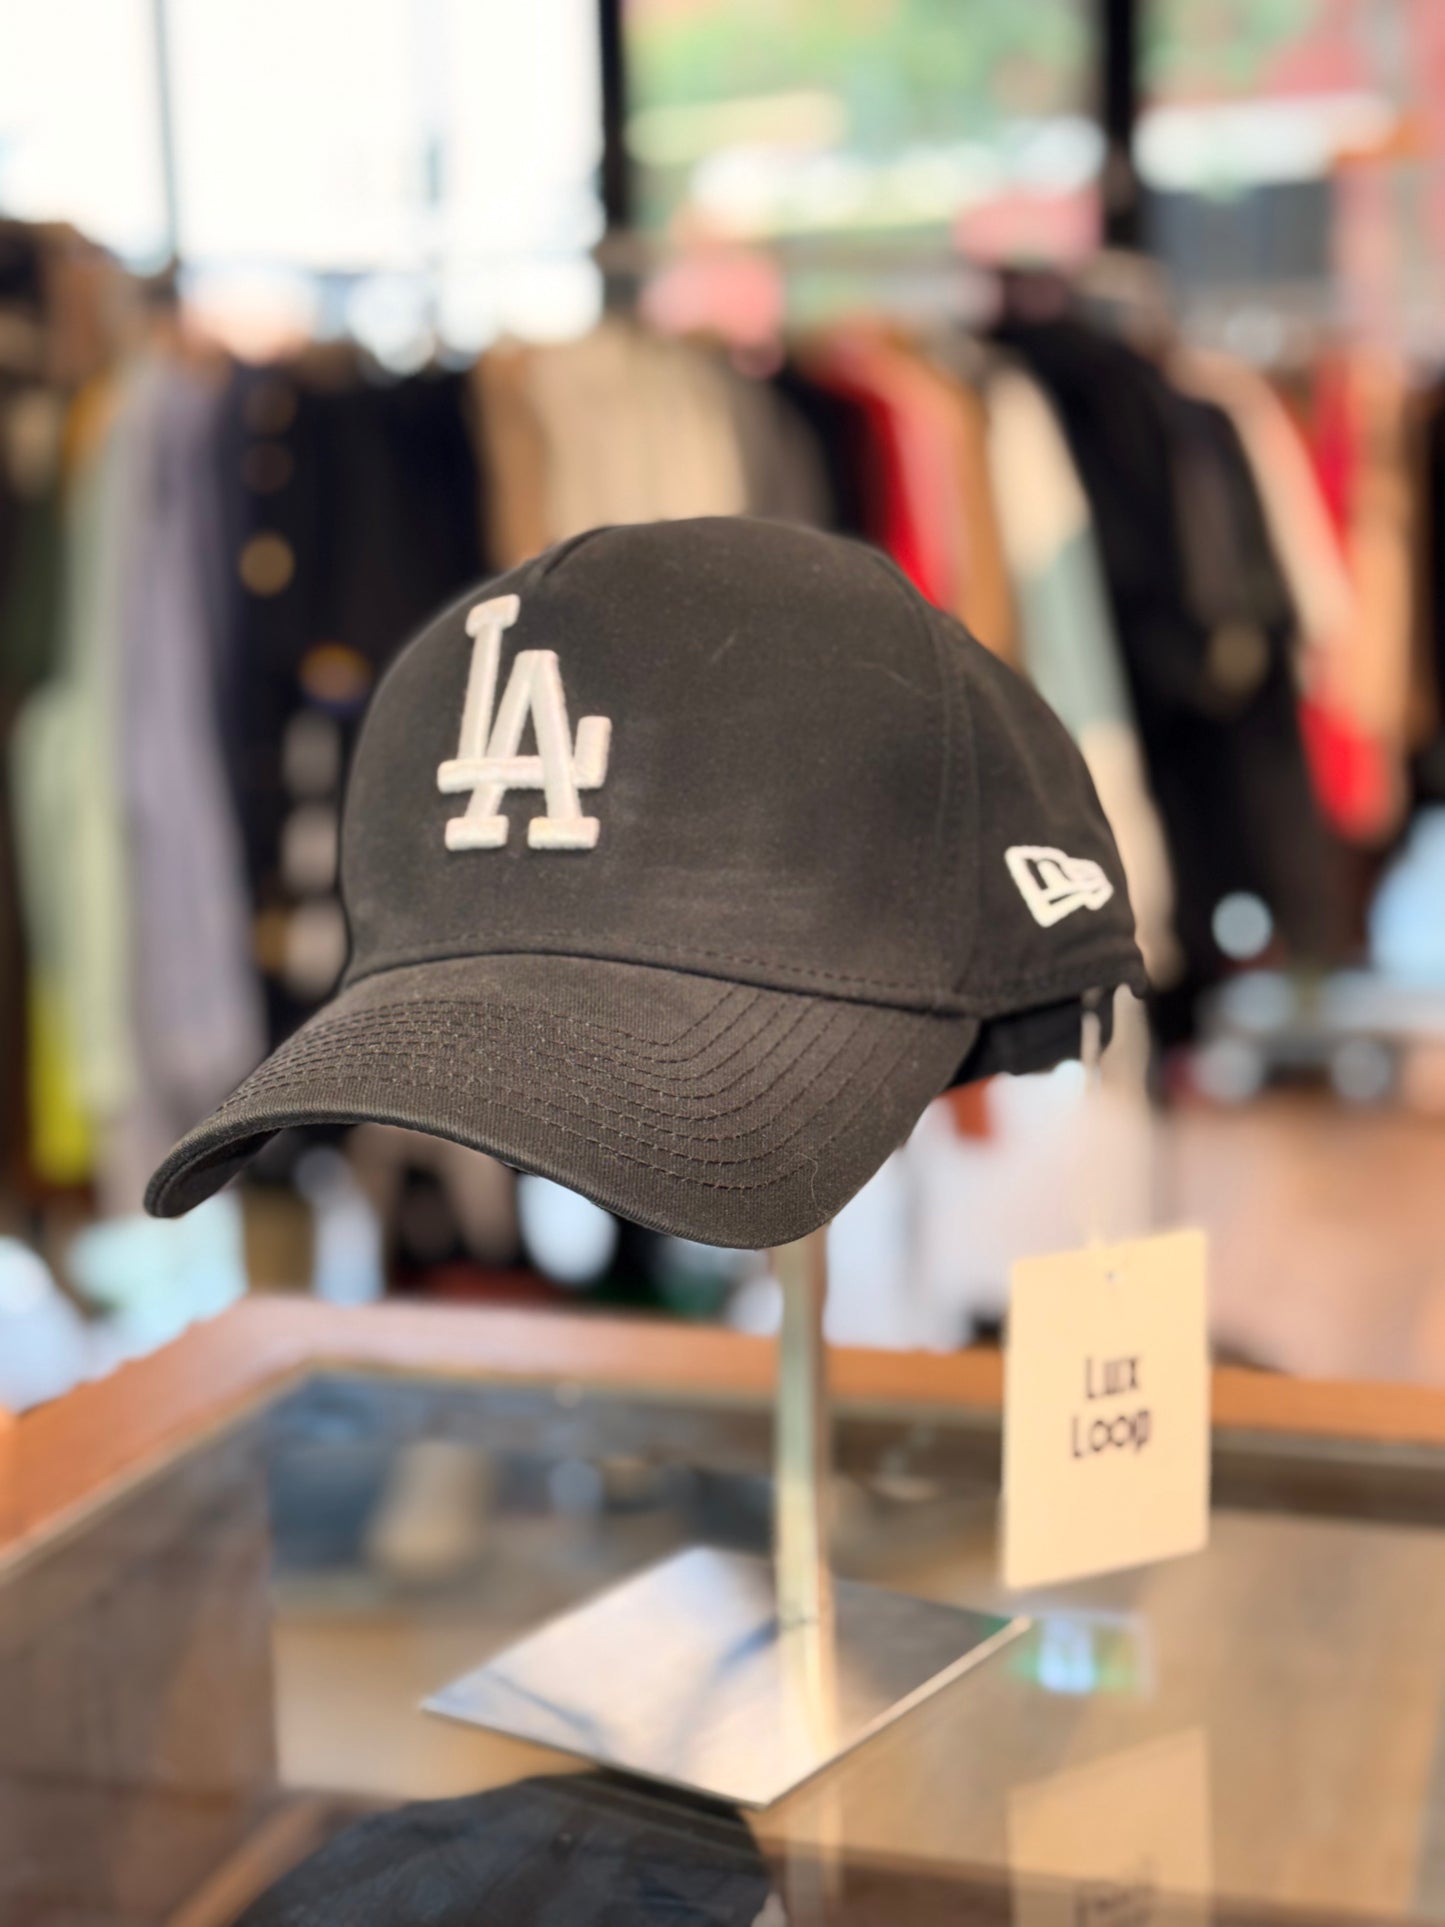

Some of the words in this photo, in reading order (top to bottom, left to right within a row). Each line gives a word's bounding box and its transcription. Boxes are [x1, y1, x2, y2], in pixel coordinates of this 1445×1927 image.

[437, 594, 612, 851] LA
[1085, 1356, 1140, 1401] Lux
[1072, 1409, 1152, 1460] Loop
